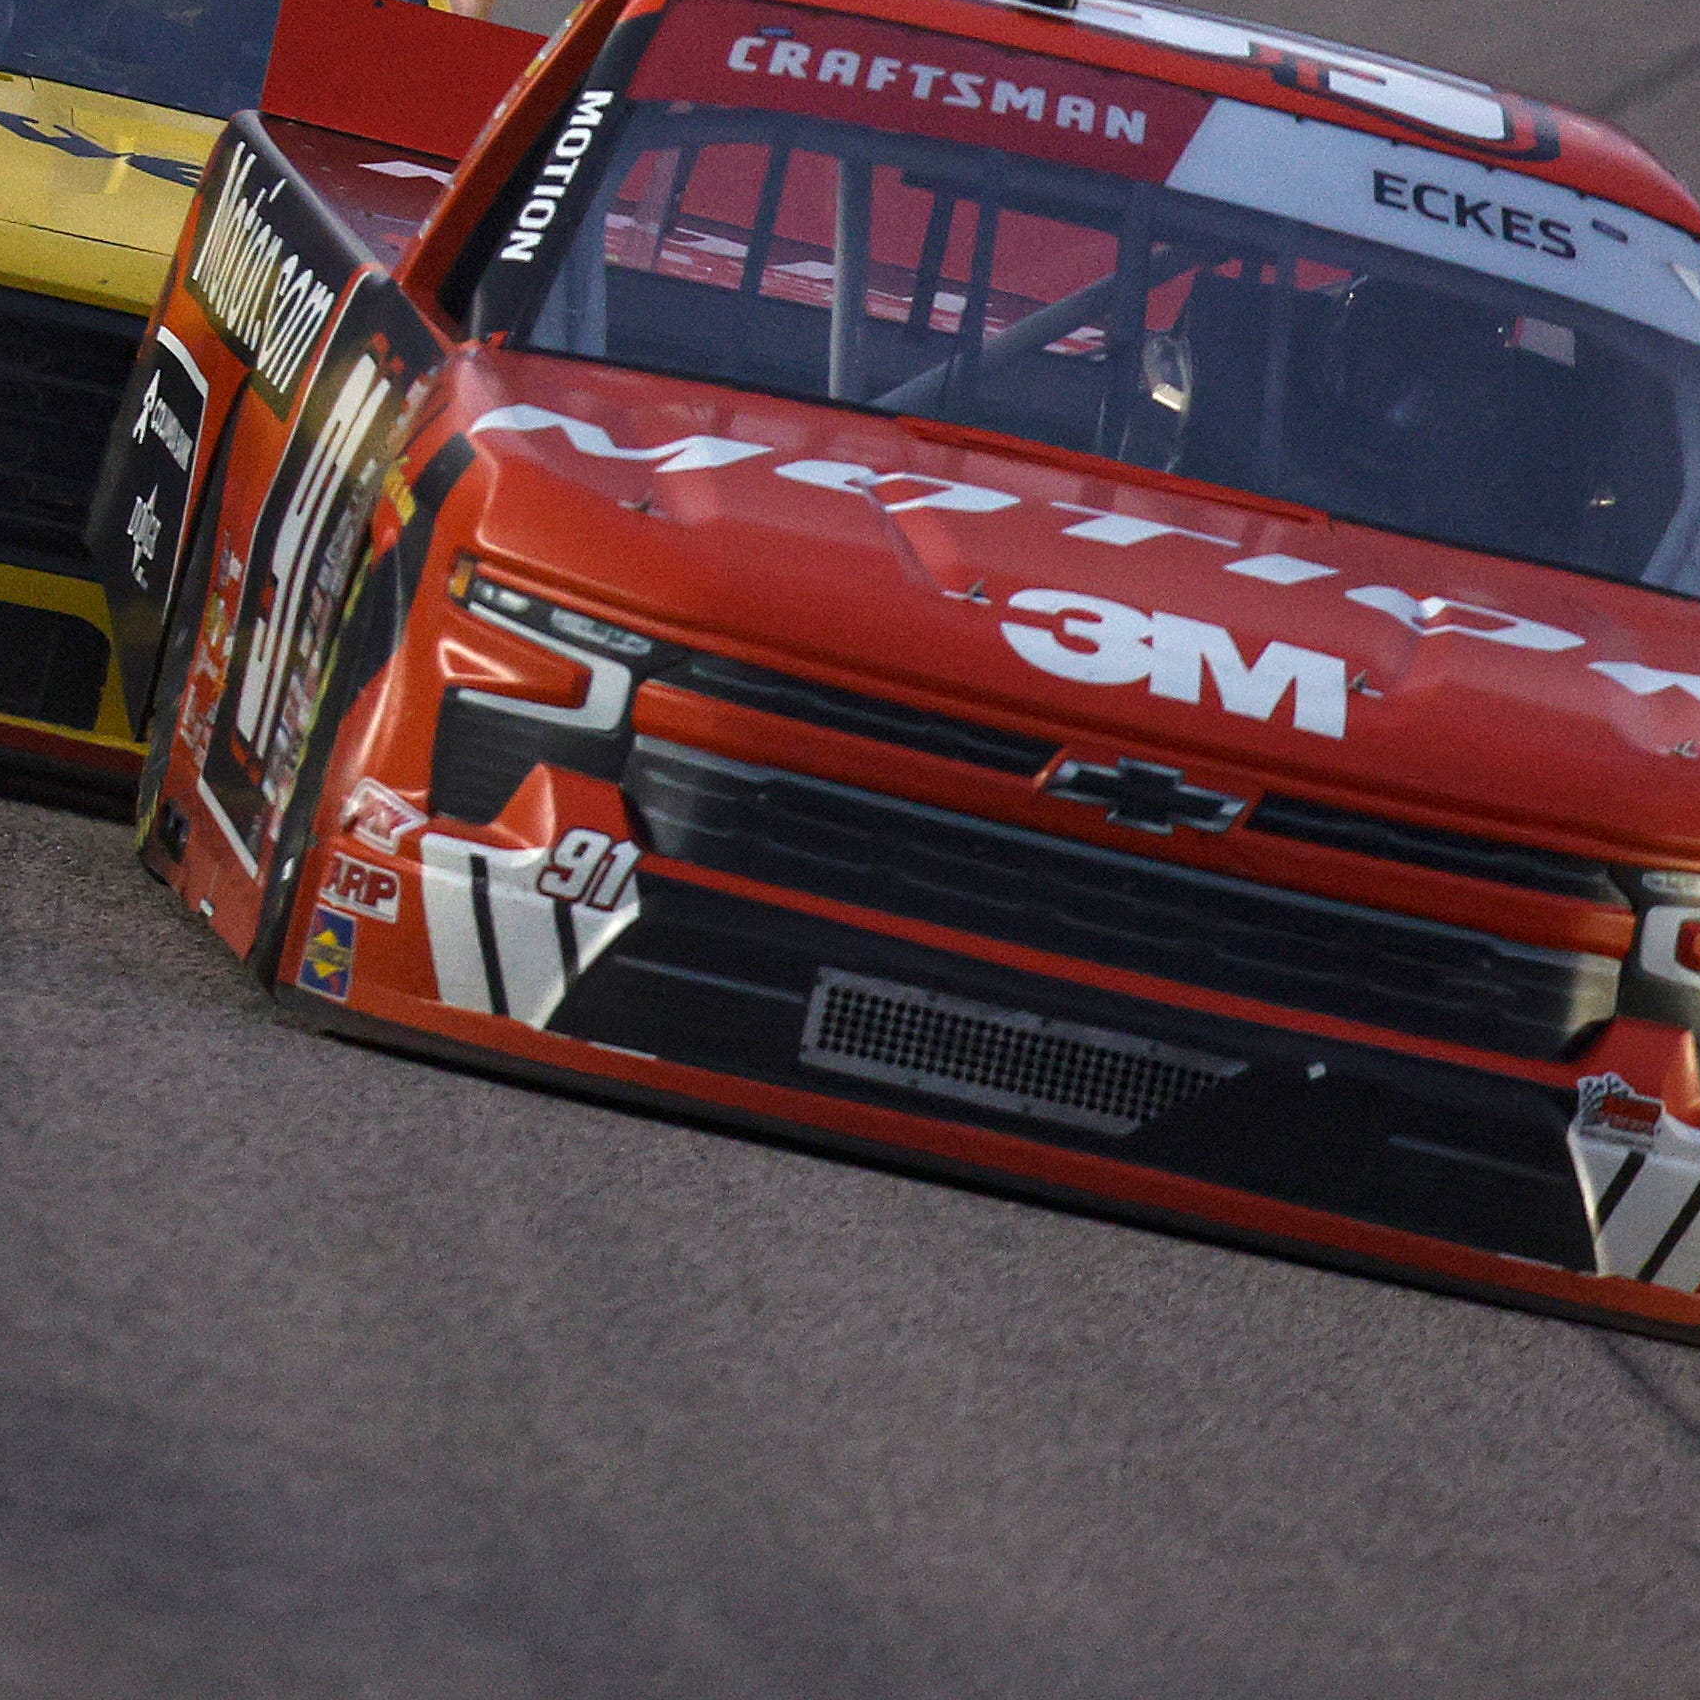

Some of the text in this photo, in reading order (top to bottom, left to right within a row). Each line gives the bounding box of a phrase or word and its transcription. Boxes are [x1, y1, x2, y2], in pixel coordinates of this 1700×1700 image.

[727, 36, 1147, 145] CRAFTSMAN
[500, 90, 614, 263] MOTION
[1373, 169, 1577, 260] ECKES
[191, 140, 336, 394] Motion.com
[1002, 587, 1348, 741] 3M
[321, 853, 399, 909] ARP
[536, 826, 642, 912] 91
